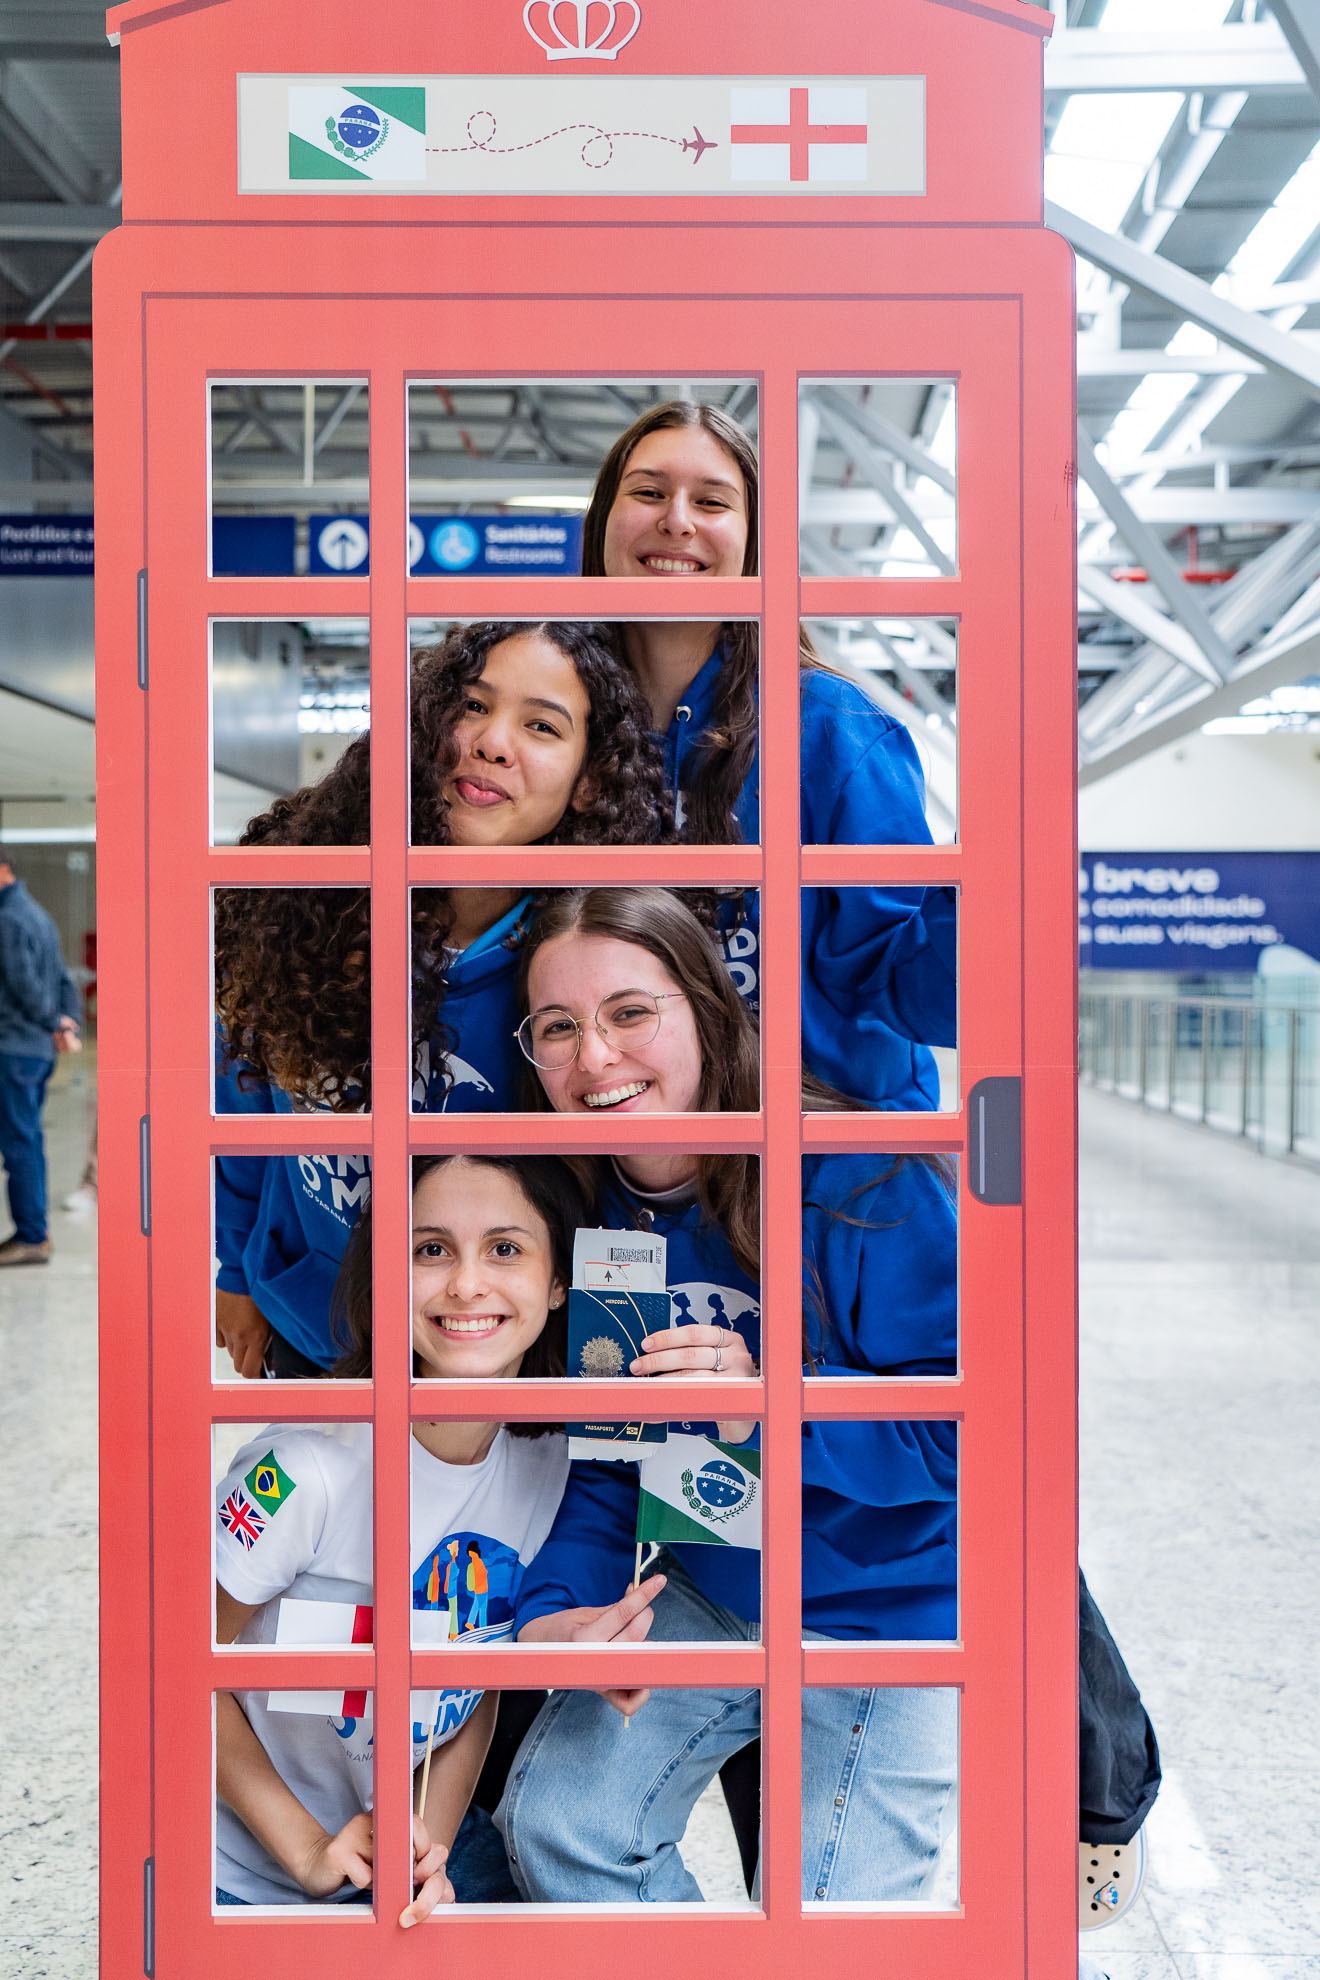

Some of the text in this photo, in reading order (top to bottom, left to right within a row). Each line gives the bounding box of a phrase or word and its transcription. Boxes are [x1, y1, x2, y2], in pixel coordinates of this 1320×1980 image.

[485, 525, 567, 543] Sanitários
[1, 548, 94, 564] Lost and fou
[485, 545, 565, 564] Restrooms
[1094, 862, 1219, 893] breve
[1093, 895, 1265, 918] comodidade
[1095, 924, 1165, 944] suas
